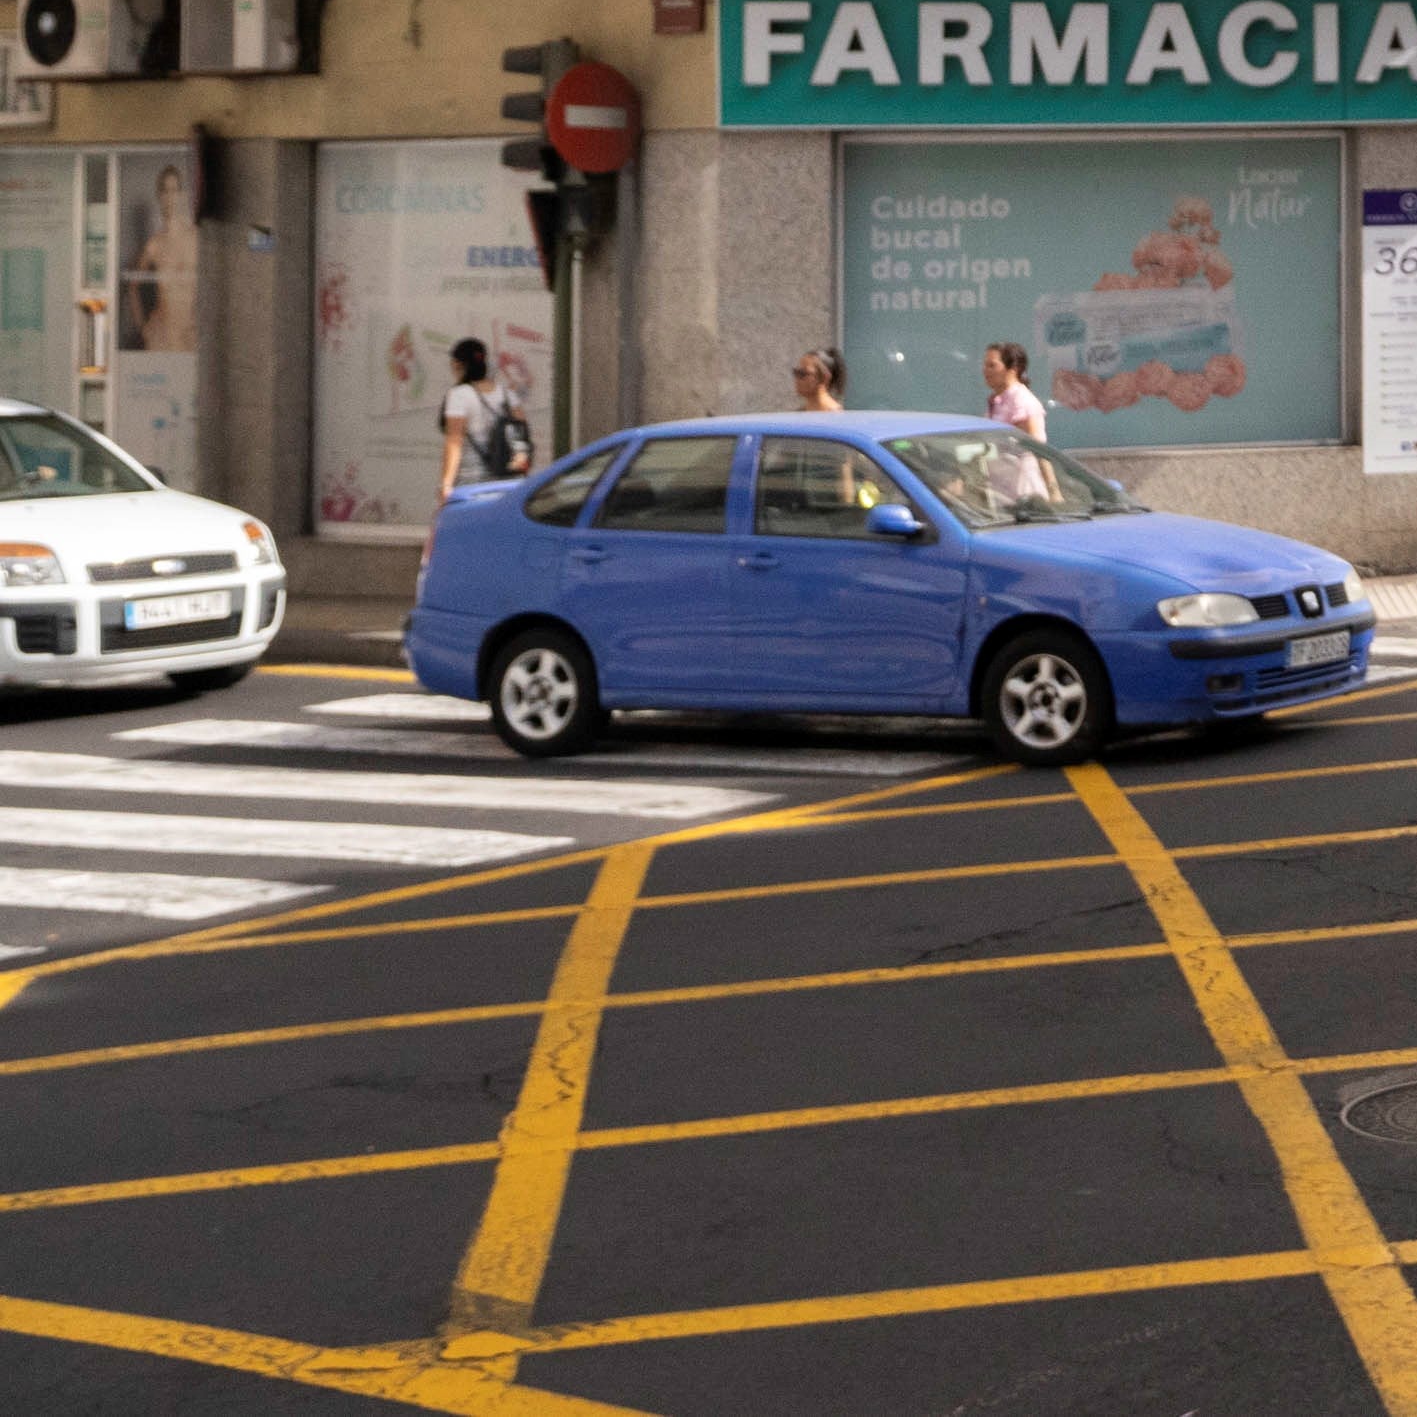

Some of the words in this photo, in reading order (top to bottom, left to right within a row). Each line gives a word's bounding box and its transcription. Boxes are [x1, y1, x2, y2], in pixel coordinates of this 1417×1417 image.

[870, 194, 1012, 220] Cuidado
[870, 223, 962, 251] bucal
[870, 255, 912, 280] de
[923, 254, 1033, 286] origen
[870, 283, 989, 311] natural
